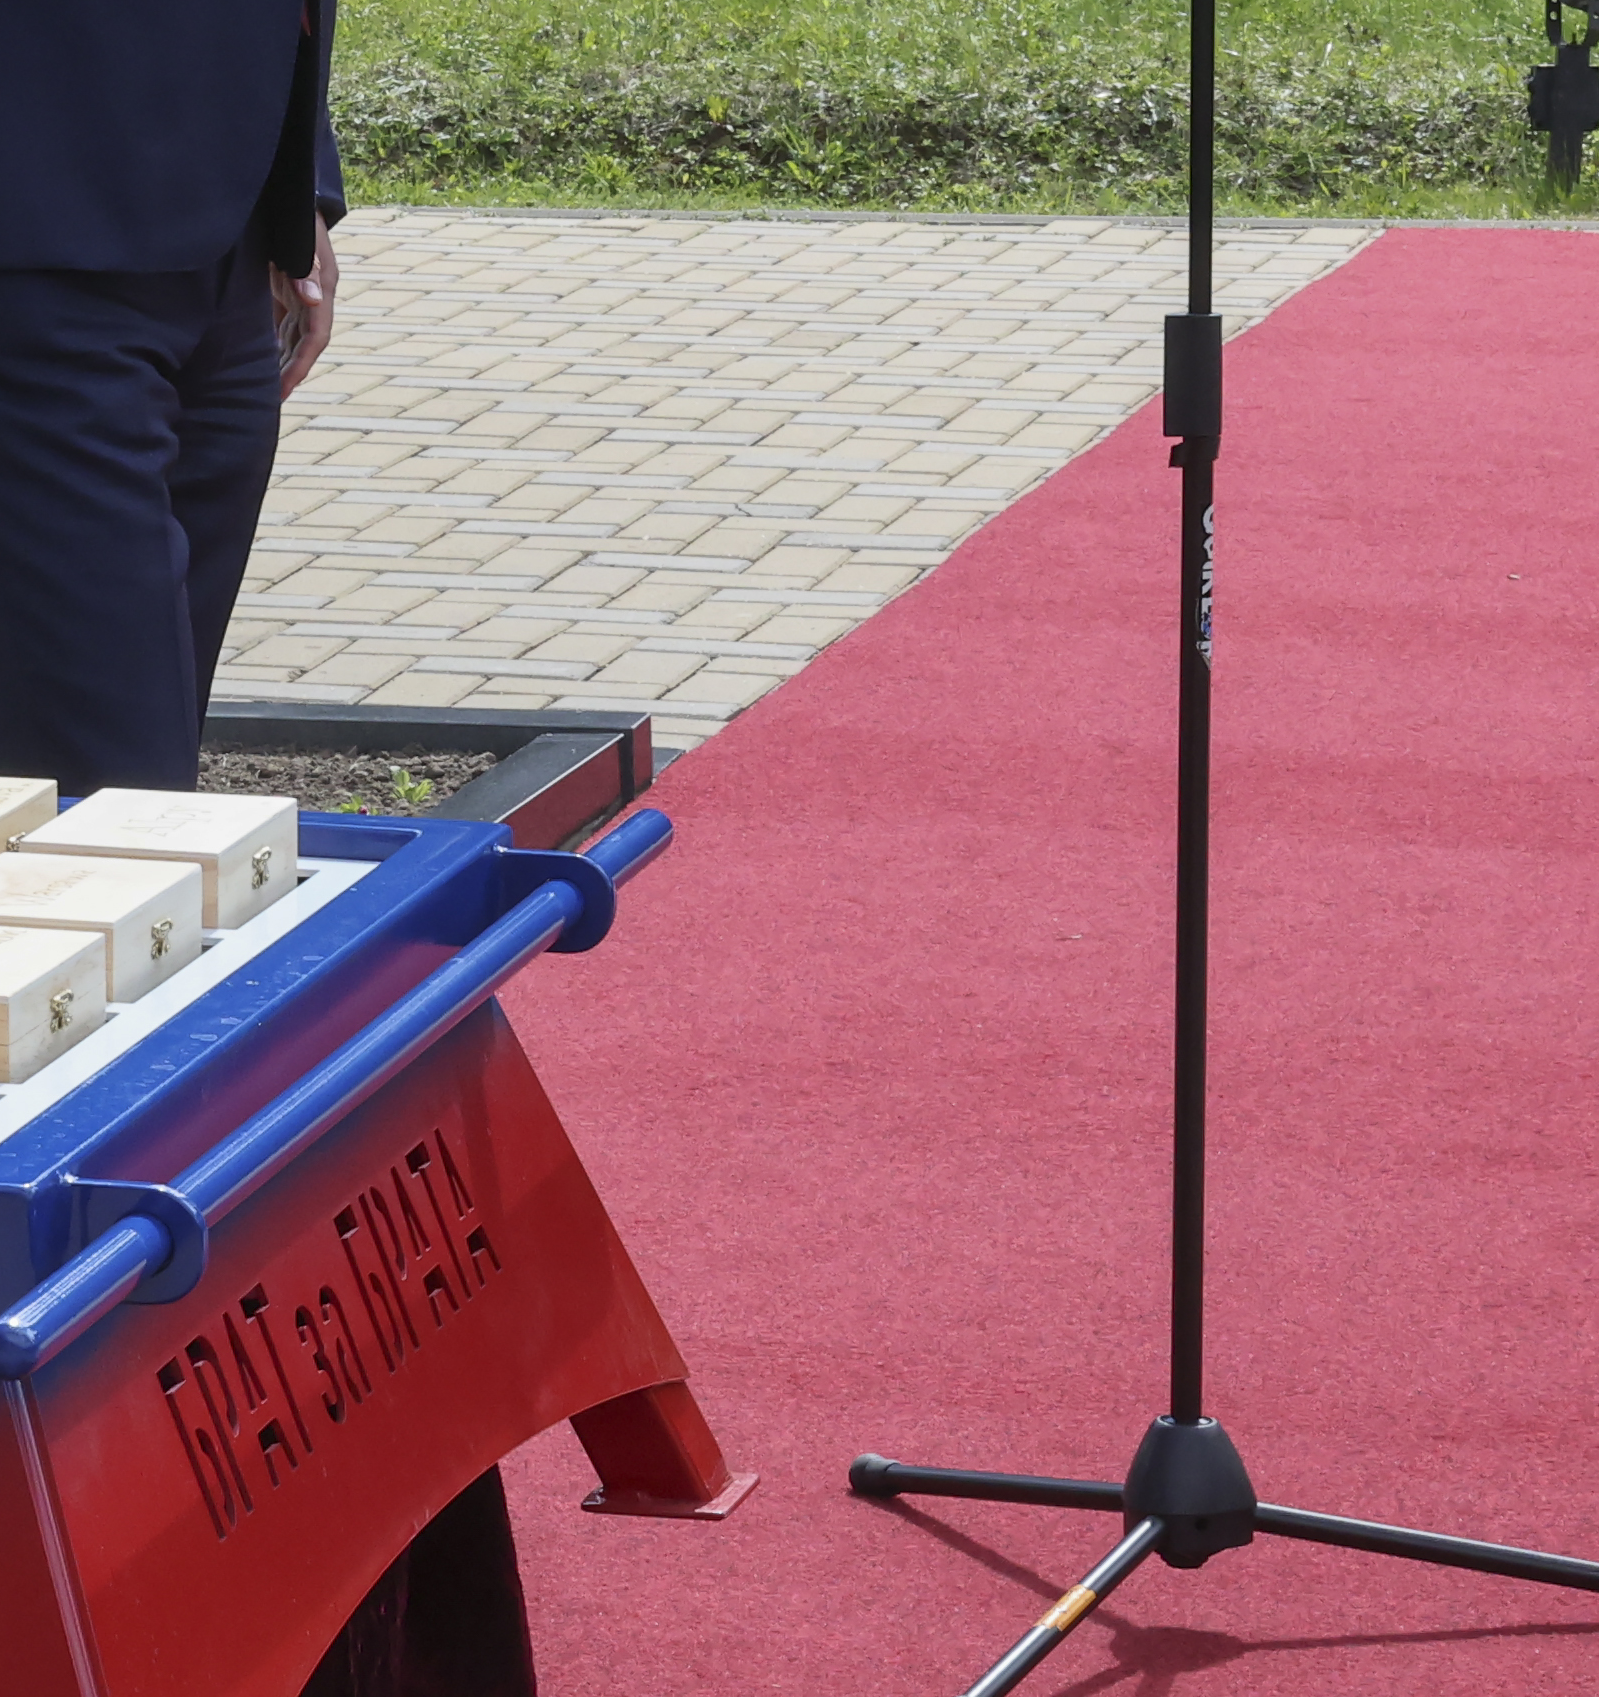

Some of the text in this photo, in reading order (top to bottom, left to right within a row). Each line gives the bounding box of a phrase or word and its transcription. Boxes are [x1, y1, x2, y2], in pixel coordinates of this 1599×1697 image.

[156, 1128, 502, 1541] БРАТ за БРАТА
